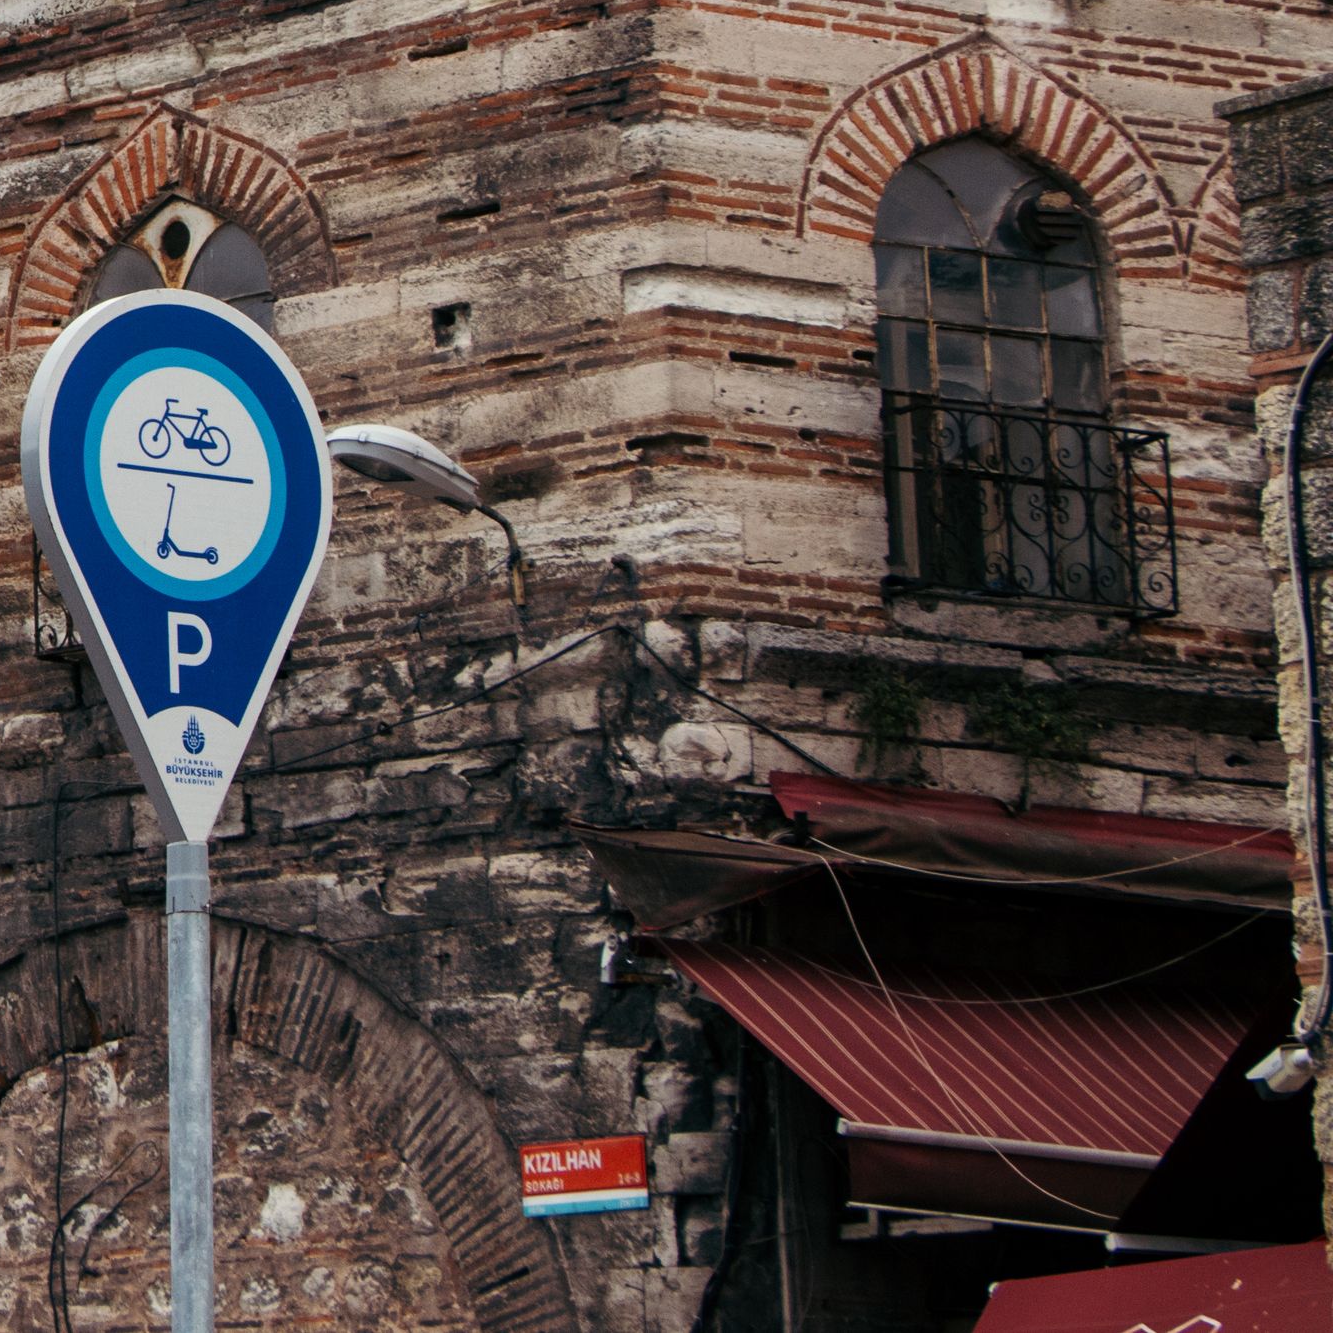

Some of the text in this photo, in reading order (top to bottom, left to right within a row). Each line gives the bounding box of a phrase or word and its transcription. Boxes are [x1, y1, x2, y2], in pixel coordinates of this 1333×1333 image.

[168, 611, 213, 694] P
[166, 764, 223, 779] BÜYÜKŞEHİR
[175, 777, 215, 786] BELEDİYESİ
[524, 1148, 602, 1174] KIZILHAN
